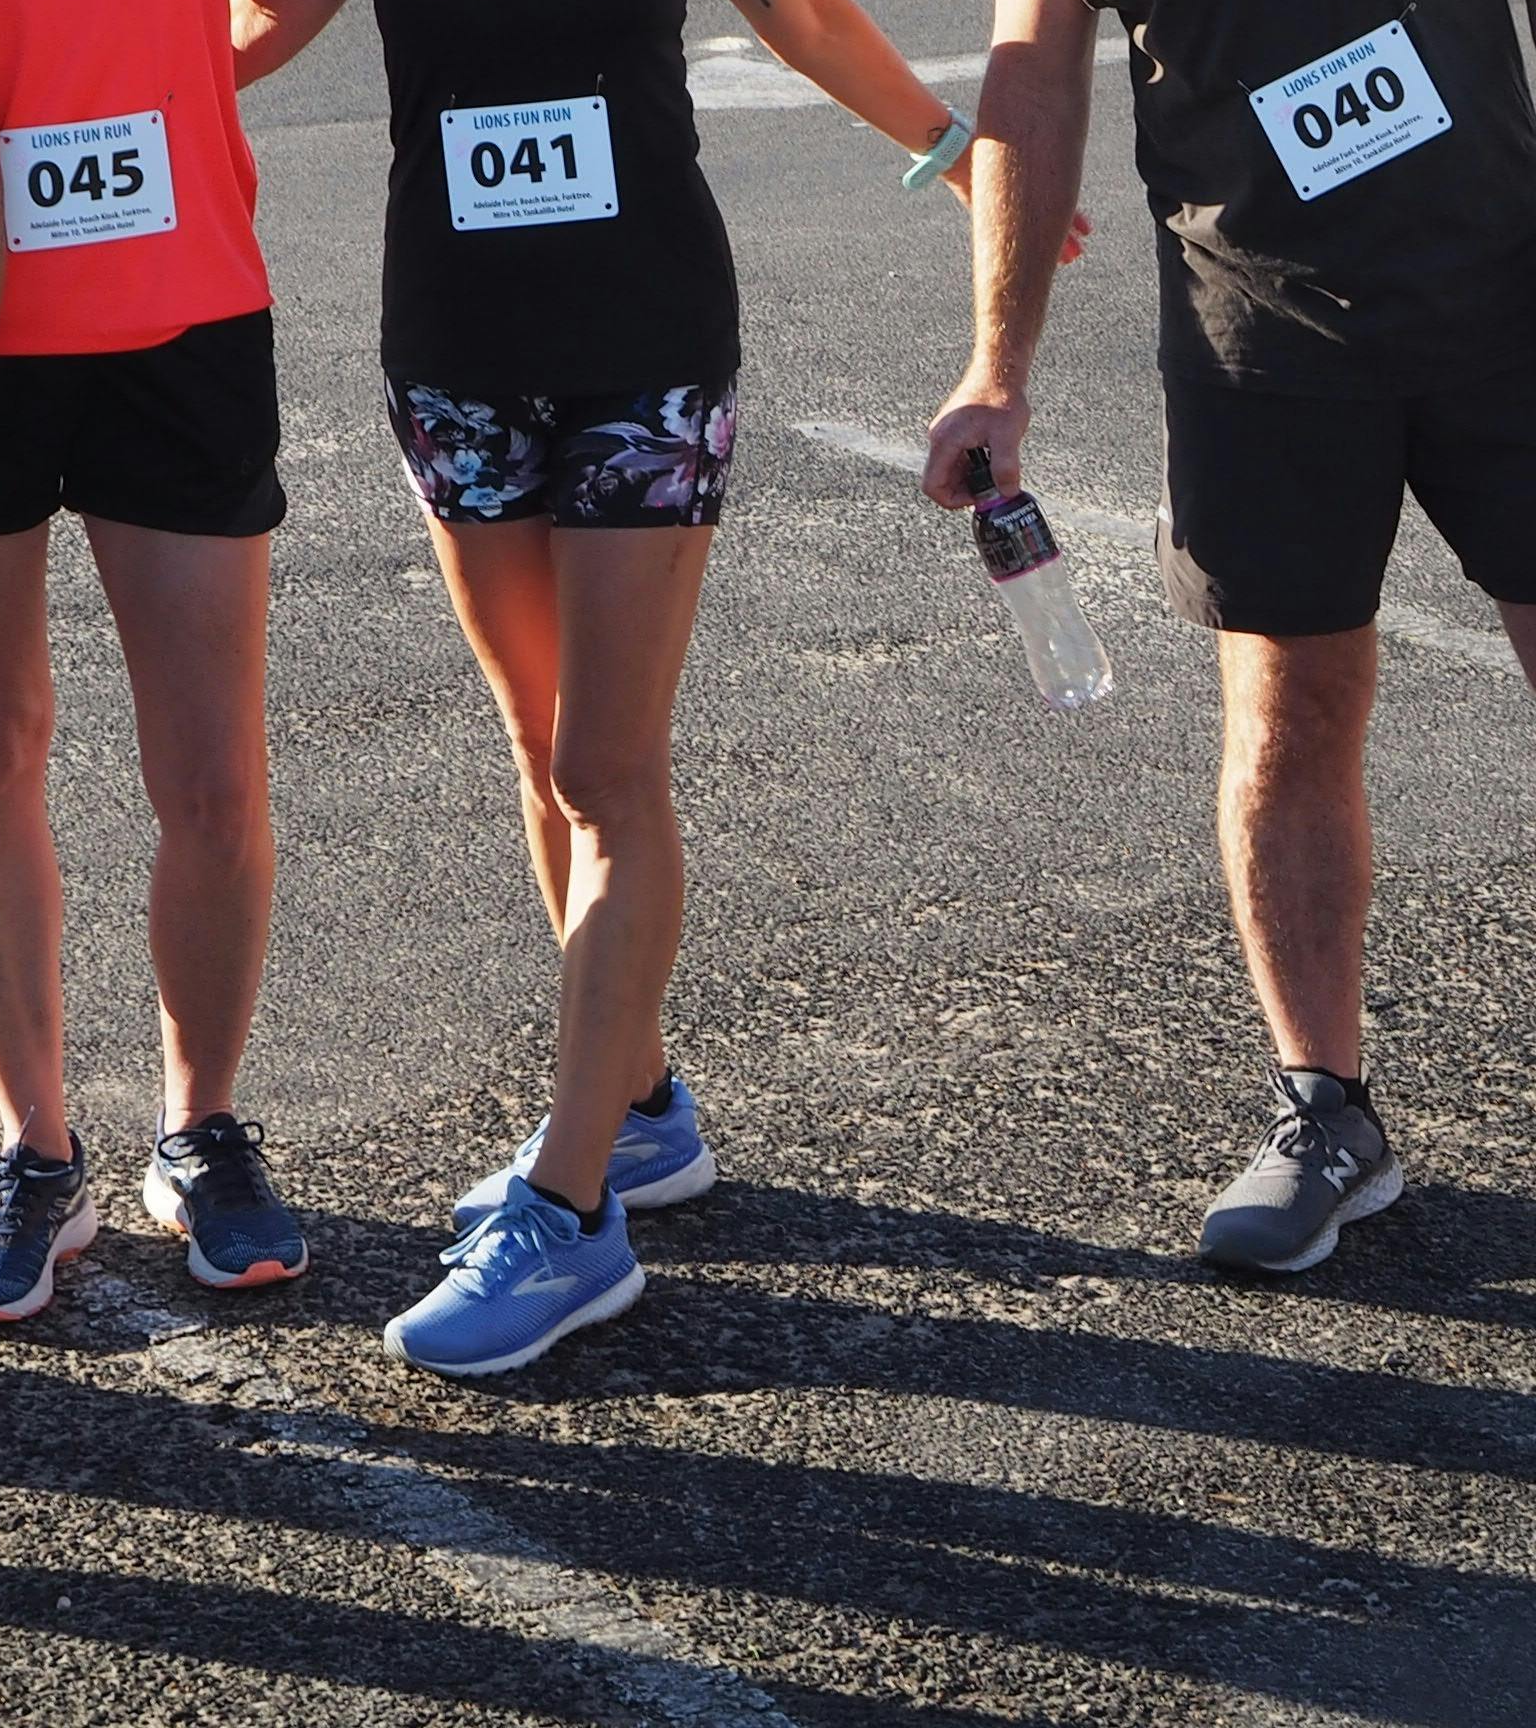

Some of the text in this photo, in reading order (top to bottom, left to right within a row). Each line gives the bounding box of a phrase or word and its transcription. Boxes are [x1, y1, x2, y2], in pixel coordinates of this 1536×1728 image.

[1282, 41, 1376, 99] LIONS FUN RUN
[473, 106, 572, 131] LIONS FUN RUN
[1292, 66, 1405, 150] 040
[31, 122, 132, 150] LIONS FUN RUN
[1354, 137, 1376, 152] Beach
[470, 133, 578, 189] 041
[27, 147, 145, 209] 045
[473, 199, 502, 210] Adelaide
[519, 195, 541, 206] Beach
[492, 211, 511, 219] Mitre
